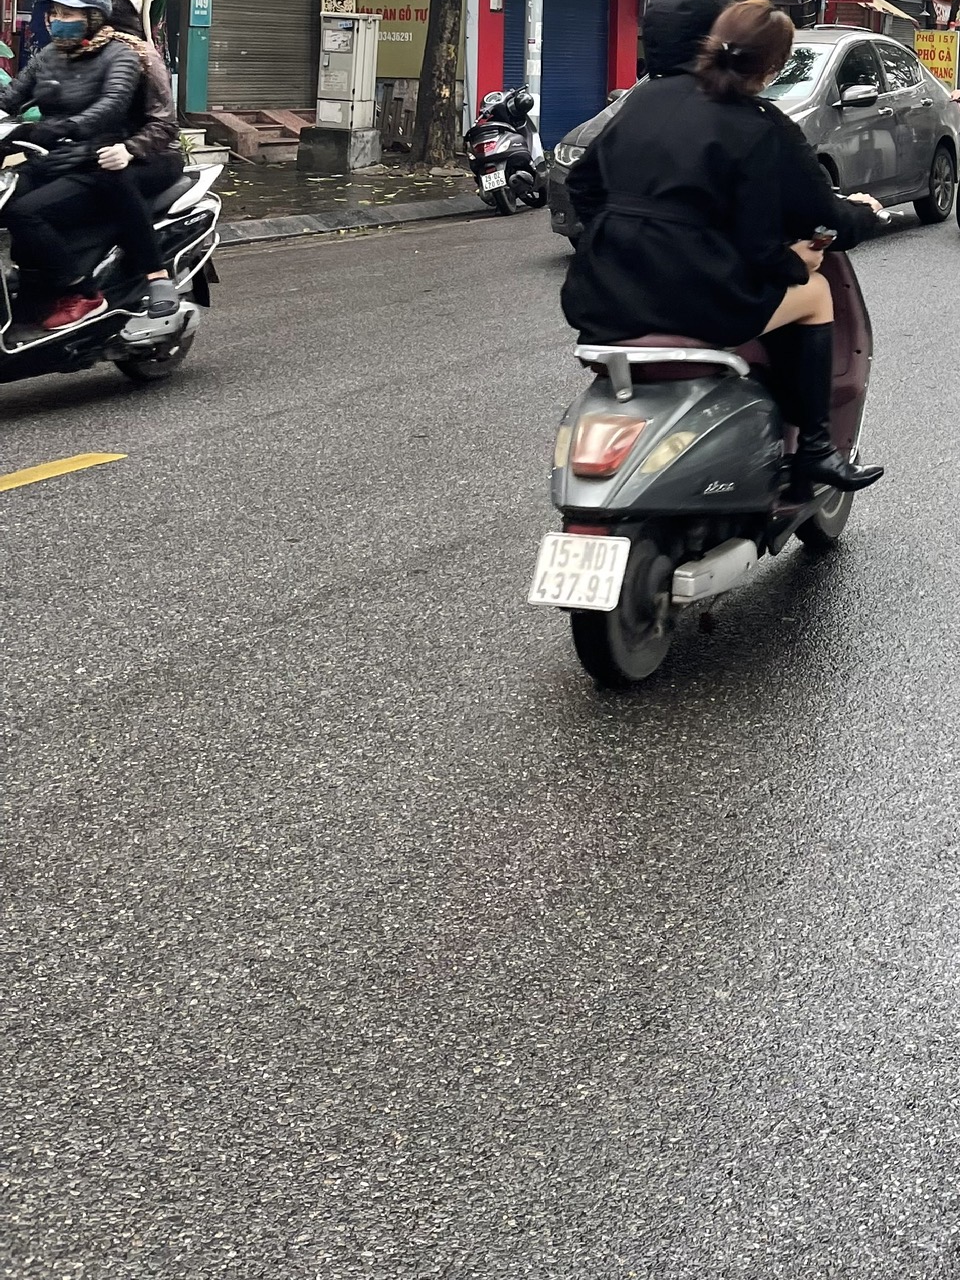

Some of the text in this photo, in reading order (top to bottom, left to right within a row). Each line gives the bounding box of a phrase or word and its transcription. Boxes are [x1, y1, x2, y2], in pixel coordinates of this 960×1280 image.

[376, 5, 396, 21] SÀN
[399, 5, 411, 21] GỖ
[414, 7, 429, 23] TỰ
[378, 32, 413, 42] 03436291
[916, 31, 954, 43] PHỞ 157
[917, 44, 952, 63] PHỞ GÀ
[550, 539, 619, 571] 15-MD1
[536, 571, 615, 605] 437.91
